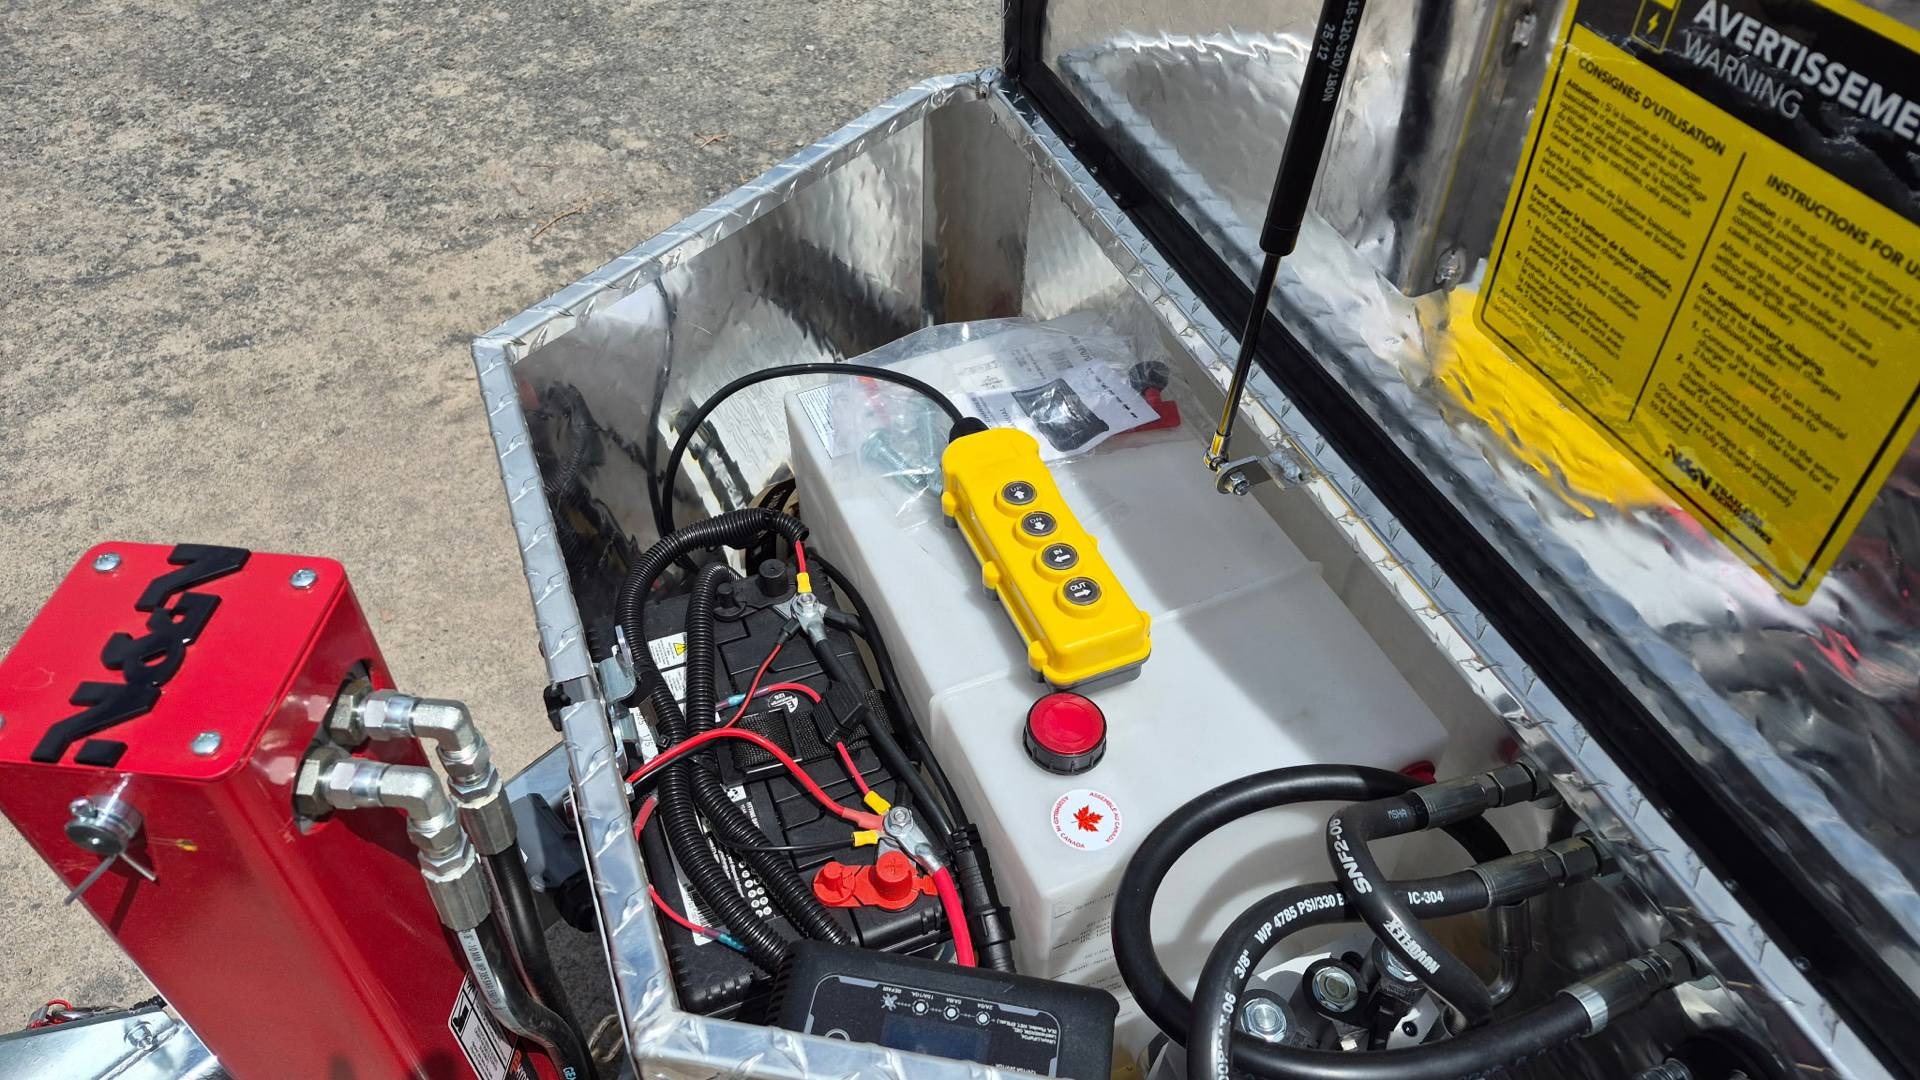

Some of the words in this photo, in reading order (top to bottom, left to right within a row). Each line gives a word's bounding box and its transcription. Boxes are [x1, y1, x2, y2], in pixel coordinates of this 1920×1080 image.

[1316, 22, 1336, 60] 25/12
[1684, 30, 1805, 121] WARNING
[1692, 0, 1920, 145] AVERTISSEME
[1578, 57, 1640, 102] CONSIGNES
[1642, 96, 1725, 155] D'UTILISATION
[1742, 191, 1776, 218] Caution
[1791, 224, 1806, 238] the
[1807, 235, 1834, 257] dump
[1836, 253, 1864, 274] trailer
[1866, 271, 1902, 301] battery
[1753, 242, 1769, 257] this
[1770, 255, 1796, 275] could
[1796, 272, 1821, 292] cause
[1767, 175, 1867, 244] INSTRUCTIONS
[1870, 239, 1903, 266] FOR
[1906, 261, 1920, 280] U
[1701, 282, 1716, 296] For
[1717, 295, 1750, 320] optimal
[1750, 317, 1783, 346] battery
[1711, 264, 1746, 290] recharge
[1747, 288, 1761, 302] the
[1715, 254, 1746, 277] without
[1787, 303, 1838, 340] discontinue
[1839, 340, 1857, 354] use
[1857, 352, 1878, 368] and
[1719, 241, 1741, 259] After
[1742, 259, 1765, 278] using
[1766, 273, 1781, 287] the
[1782, 285, 1808, 306] dump
[1809, 302, 1836, 323] trailer
[1846, 328, 1872, 350] times
[1785, 250, 1803, 267] may
[1861, 301, 1902, 330] extreme
[1820, 256, 1836, 272] the
[1868, 290, 1889, 306] and
[1698, 294, 1728, 320] connect
[1747, 329, 1764, 345] two
[1765, 343, 1803, 371] different
[1803, 371, 1840, 400] chargers
[1702, 309, 1715, 322] the
[1716, 318, 1753, 352] following
[1754, 348, 1776, 366] order
[1658, 382, 1677, 401] Once
[1678, 399, 1699, 418] these
[1700, 416, 1715, 431] two
[1716, 430, 1736, 449] steps
[1737, 448, 1751, 461] are
[1678, 380, 1696, 397] least
[1697, 340, 1726, 363] charger
[1747, 376, 1768, 395] least
[1781, 403, 1804, 422] amps
[1805, 419, 1818, 432] for
[1702, 328, 1734, 356] Connect
[1735, 354, 1749, 368] the
[1750, 364, 1780, 391] battery
[1805, 406, 1847, 440] industrial
[1652, 392, 1666, 409] the
[1667, 401, 1693, 429] battery
[1702, 430, 1719, 448] fully
[1718, 445, 1752, 473] charged
[1751, 472, 1769, 487] and
[1768, 486, 1791, 507] ready
[1681, 373, 1711, 401] charger
[1710, 396, 1747, 425] provided
[1747, 424, 1766, 440] with
[1767, 438, 1781, 451] the
[1782, 450, 1807, 471] trailer
[1808, 469, 1822, 483] for
[1709, 381, 1740, 406] connect
[1741, 404, 1755, 418] the
[1755, 415, 1785, 443] battery
[1798, 449, 1813, 463] the
[1813, 462, 1839, 484] smart
[1070, 582, 1087, 592] OUT
[1060, 832, 1086, 848] CANADA
[1105, 821, 1120, 843] CANADA
[1330, 818, 1373, 894] SNF2-06
[1233, 949, 1251, 980] 3/8"
[1254, 922, 1273, 944] WP
[1274, 908, 1298, 928] 4785
[1297, 896, 1336, 916] PSI/330
[1408, 890, 1444, 905] IC-304
[1383, 916, 1441, 975] NUVOFLEX
